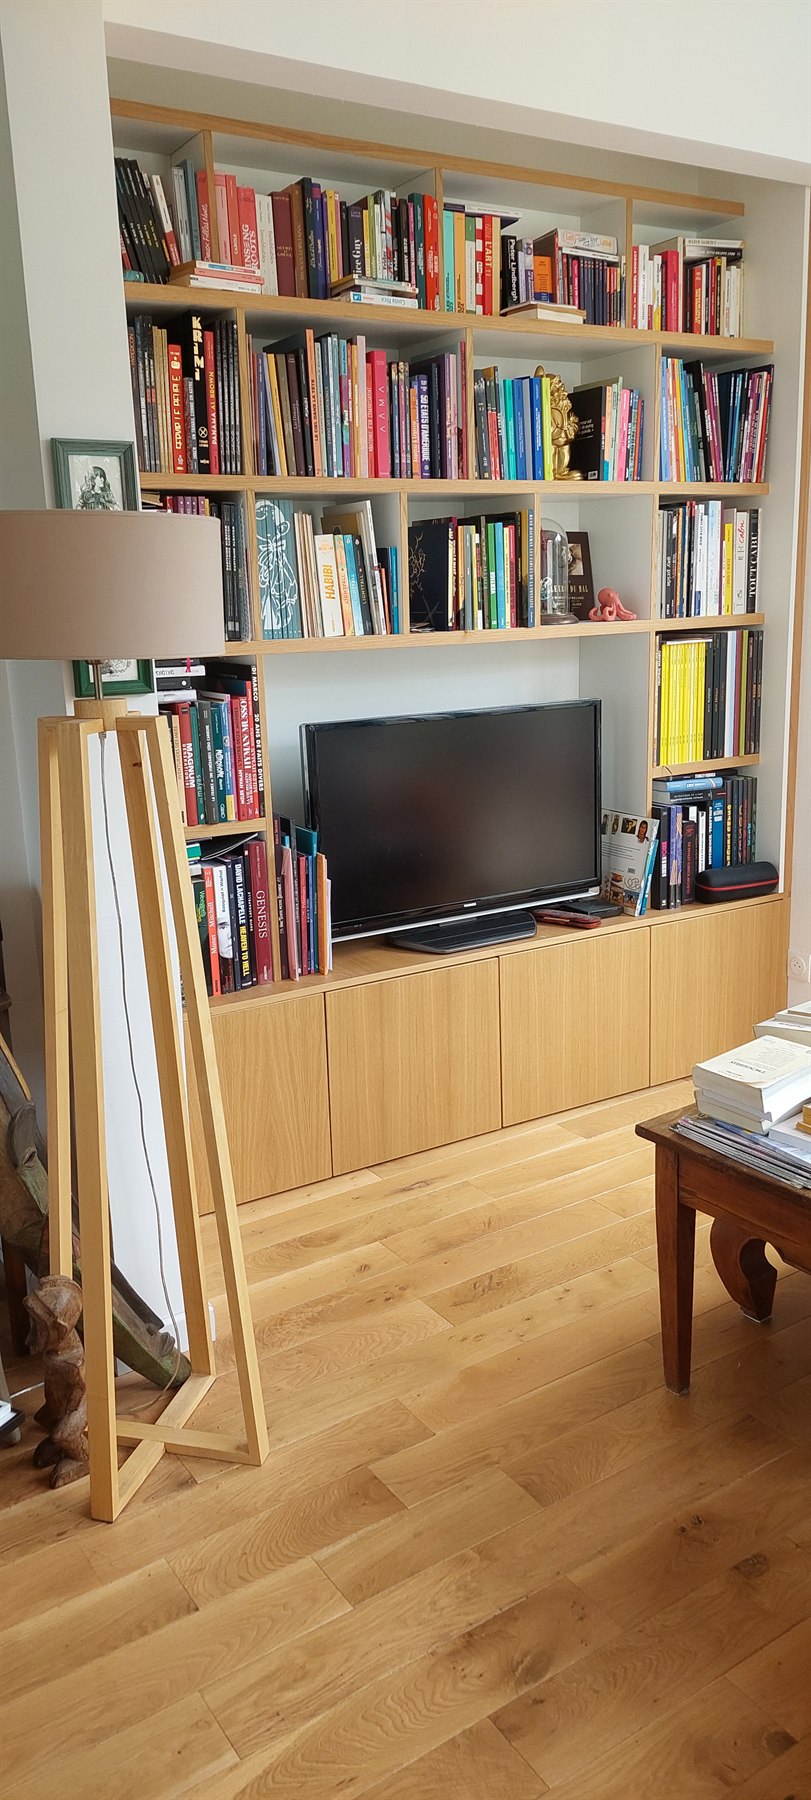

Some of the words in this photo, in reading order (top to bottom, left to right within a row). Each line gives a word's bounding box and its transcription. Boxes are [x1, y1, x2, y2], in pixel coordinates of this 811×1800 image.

[249, 230, 258, 268] ROOTS
[352, 238, 362, 258] Guy
[510, 261, 518, 301] Lindbergh
[192, 316, 204, 381] KRIMI
[421, 395, 428, 404] 50
[750, 532, 758, 564] CABU
[323, 564, 336, 600] HABIBI
[341, 574, 349, 604] LIGHTFALL
[359, 574, 367, 604] LIGHTFALL
[251, 666, 257, 676] DI
[240, 700, 248, 733] MUSSO
[255, 714, 259, 722] 20
[241, 735, 251, 769] HYMAN
[256, 739, 261, 747] DE
[186, 743, 195, 788] MAGNUM
[236, 884, 245, 924] LACHAPELLE
[256, 890, 268, 938] GENESIS
[240, 926, 248, 950] HEAVEN
[242, 951, 249, 960] TO
